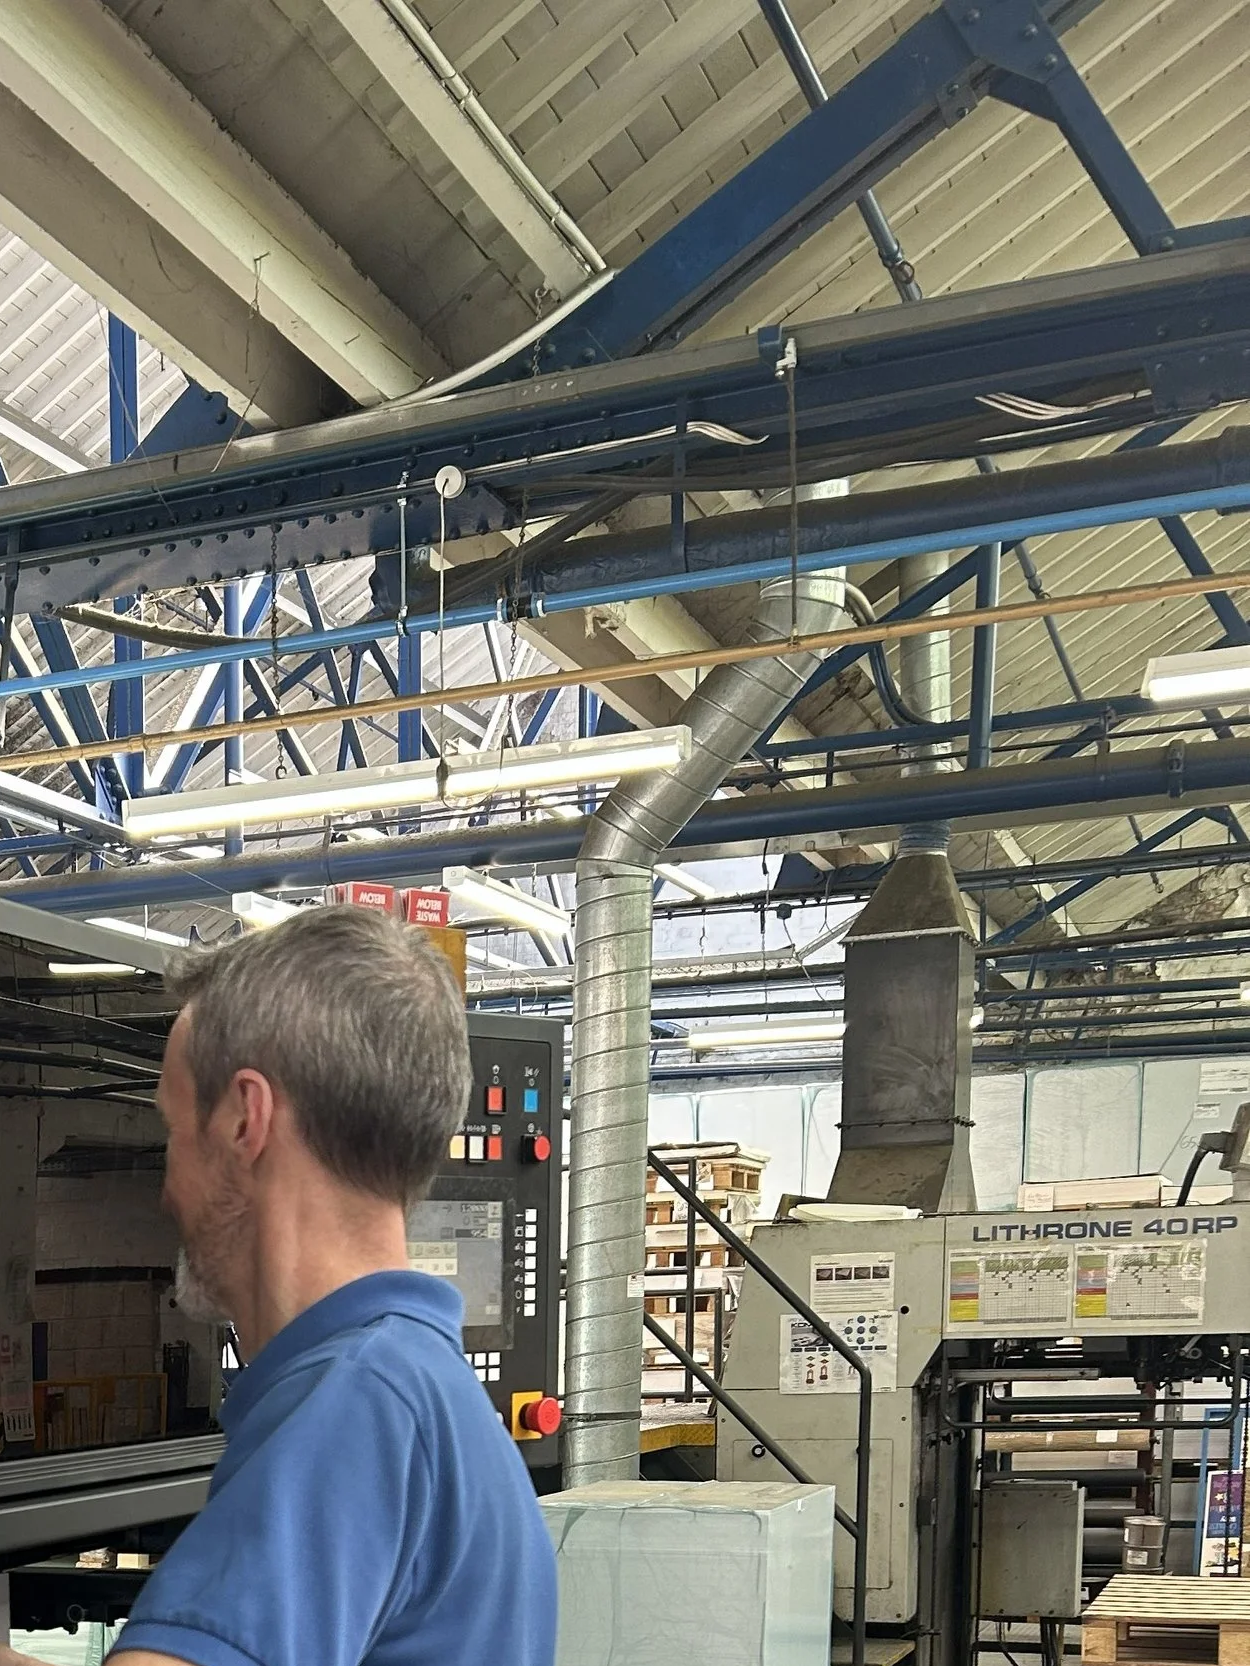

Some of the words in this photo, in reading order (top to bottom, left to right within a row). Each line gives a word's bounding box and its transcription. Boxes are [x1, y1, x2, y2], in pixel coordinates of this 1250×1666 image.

[359, 892, 386, 905] BELOW
[416, 898, 442, 911] BELOW
[415, 911, 441, 923] WASTE
[973, 1219, 1133, 1242] LITHRONE
